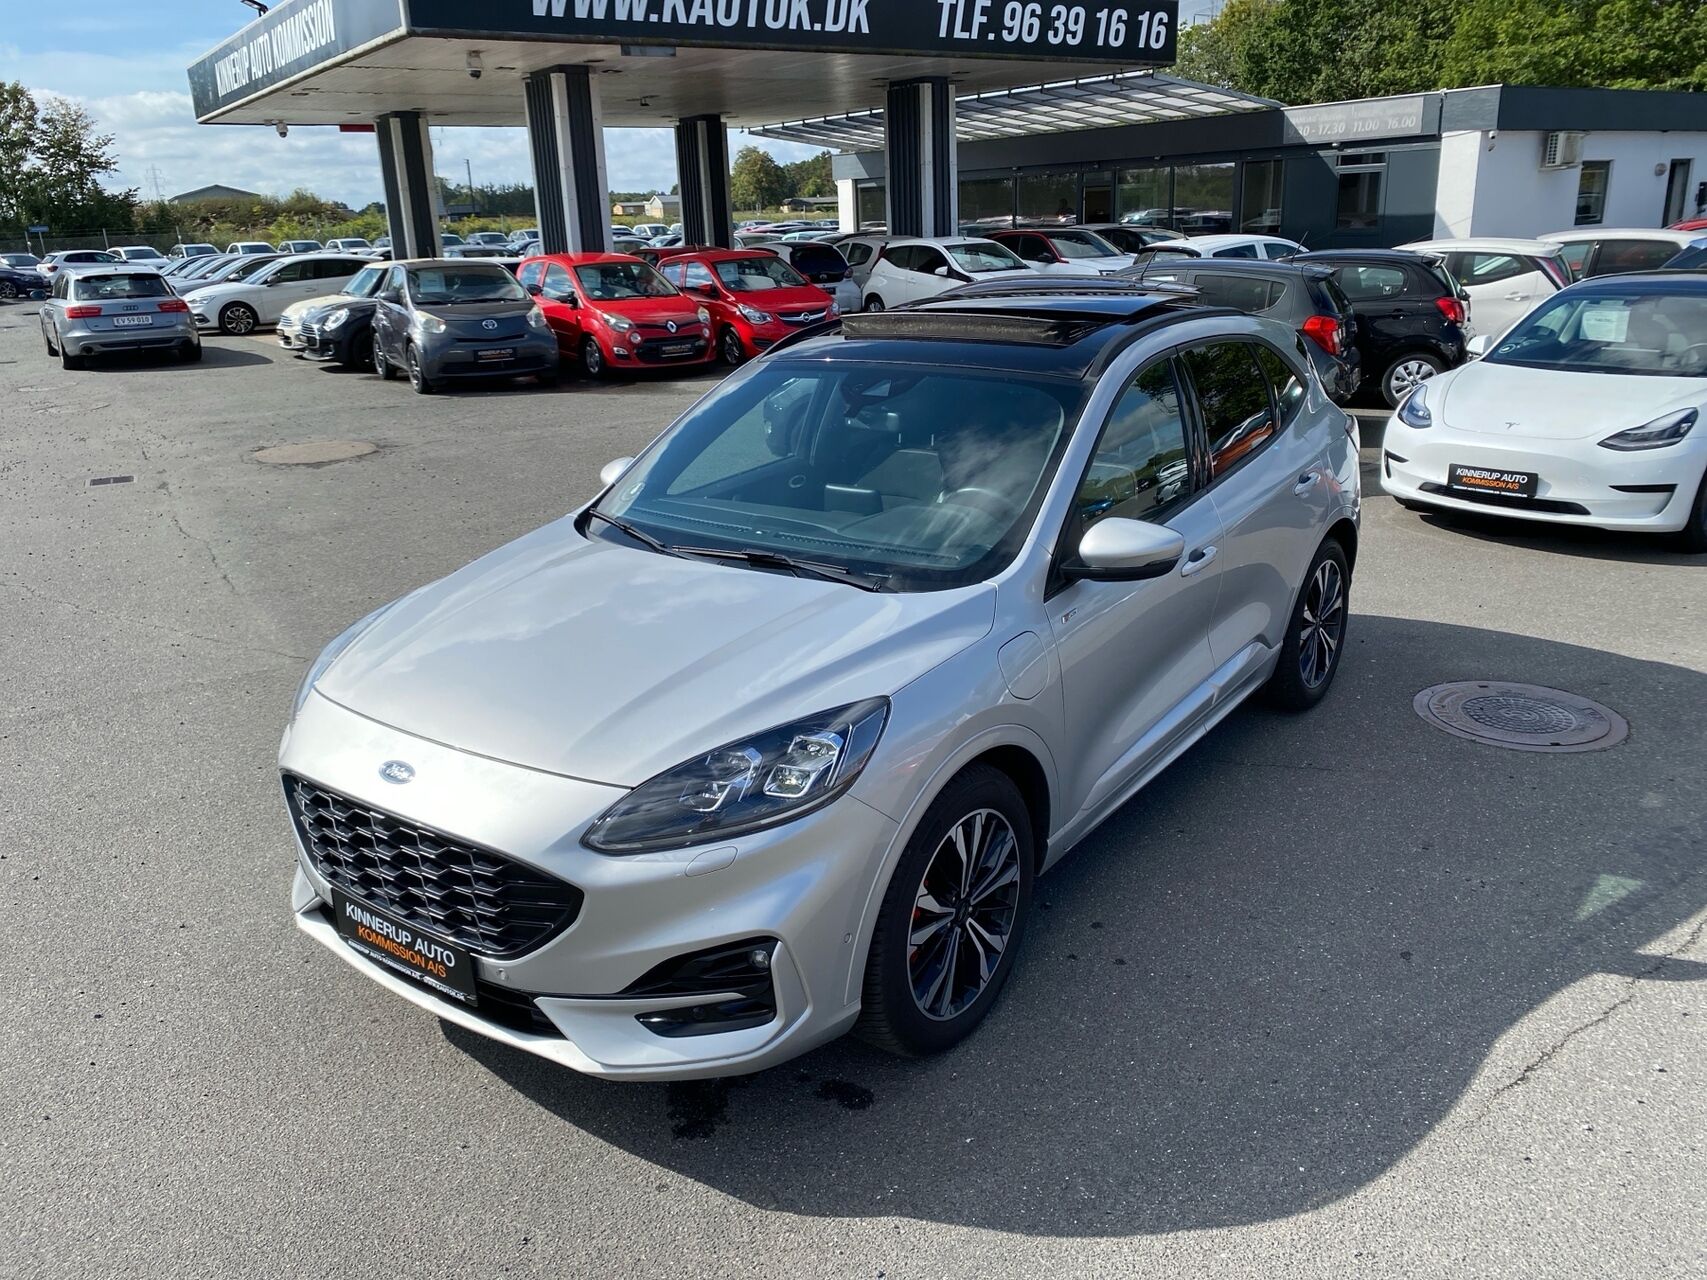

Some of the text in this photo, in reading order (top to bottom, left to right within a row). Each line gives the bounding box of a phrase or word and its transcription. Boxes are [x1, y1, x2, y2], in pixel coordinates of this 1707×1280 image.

[249, 32, 272, 81] AUTO
[271, 0, 336, 70] KOMMISSION
[937, 0, 1169, 50] TLF. 96 39 16 16
[1353, 119, 1379, 133] 11.00
[1387, 116, 1416, 130] 16.00
[1456, 468, 1528, 484] KINNERUP AUTO
[1462, 477, 1506, 489] KOMMISSION
[345, 902, 412, 945] KINNERUP
[414, 938, 456, 968] AUTO
[358, 926, 426, 968] KOMMISSION
[427, 960, 447, 978] A/S
